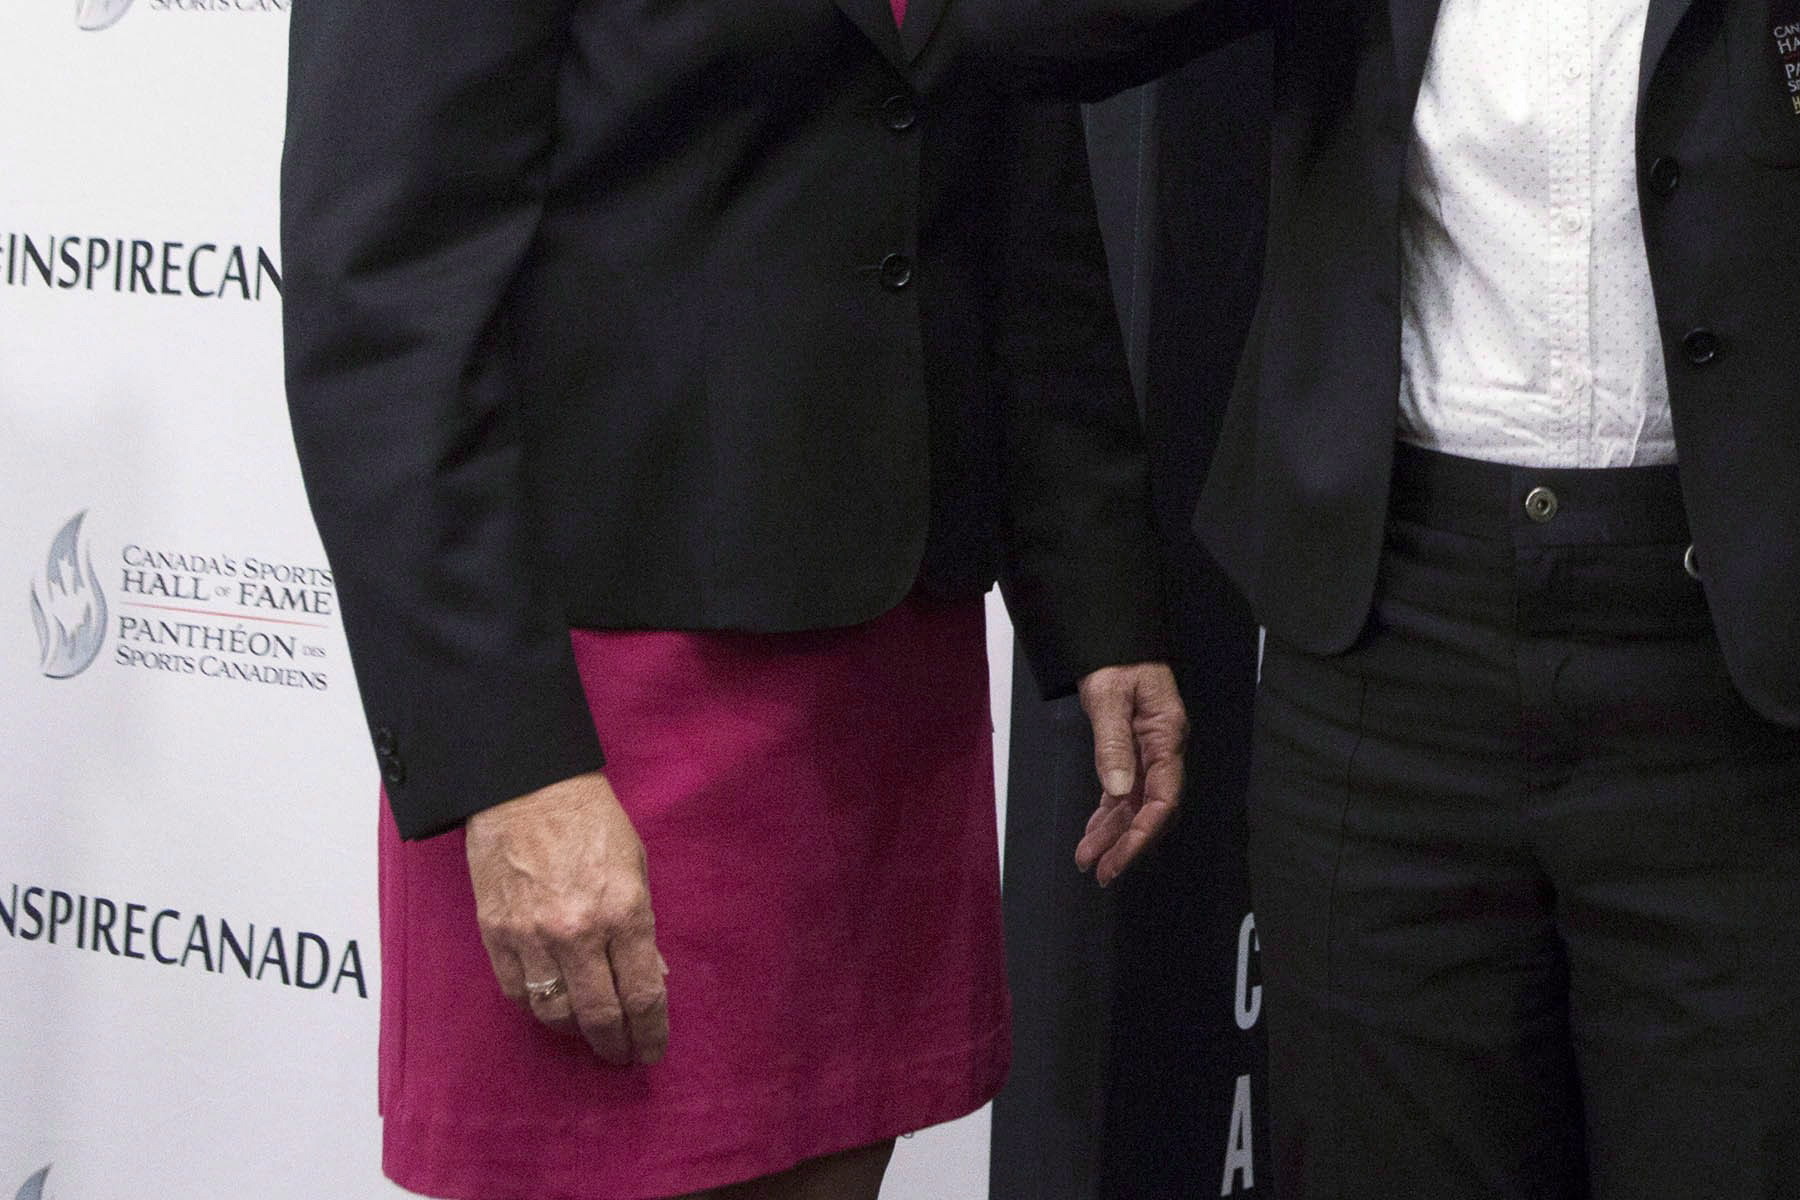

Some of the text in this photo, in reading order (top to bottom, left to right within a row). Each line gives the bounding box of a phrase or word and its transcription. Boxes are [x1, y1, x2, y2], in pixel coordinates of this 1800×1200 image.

[0, 233, 283, 301] INSPIRECAN
[121, 569, 332, 615] HALL OF FAME
[243, 558, 332, 587] SPORTS
[118, 615, 327, 660] PANTHÉON DES
[115, 646, 328, 692] SPORTS CANADIENS
[0, 884, 368, 999] NSPIRECANADA
